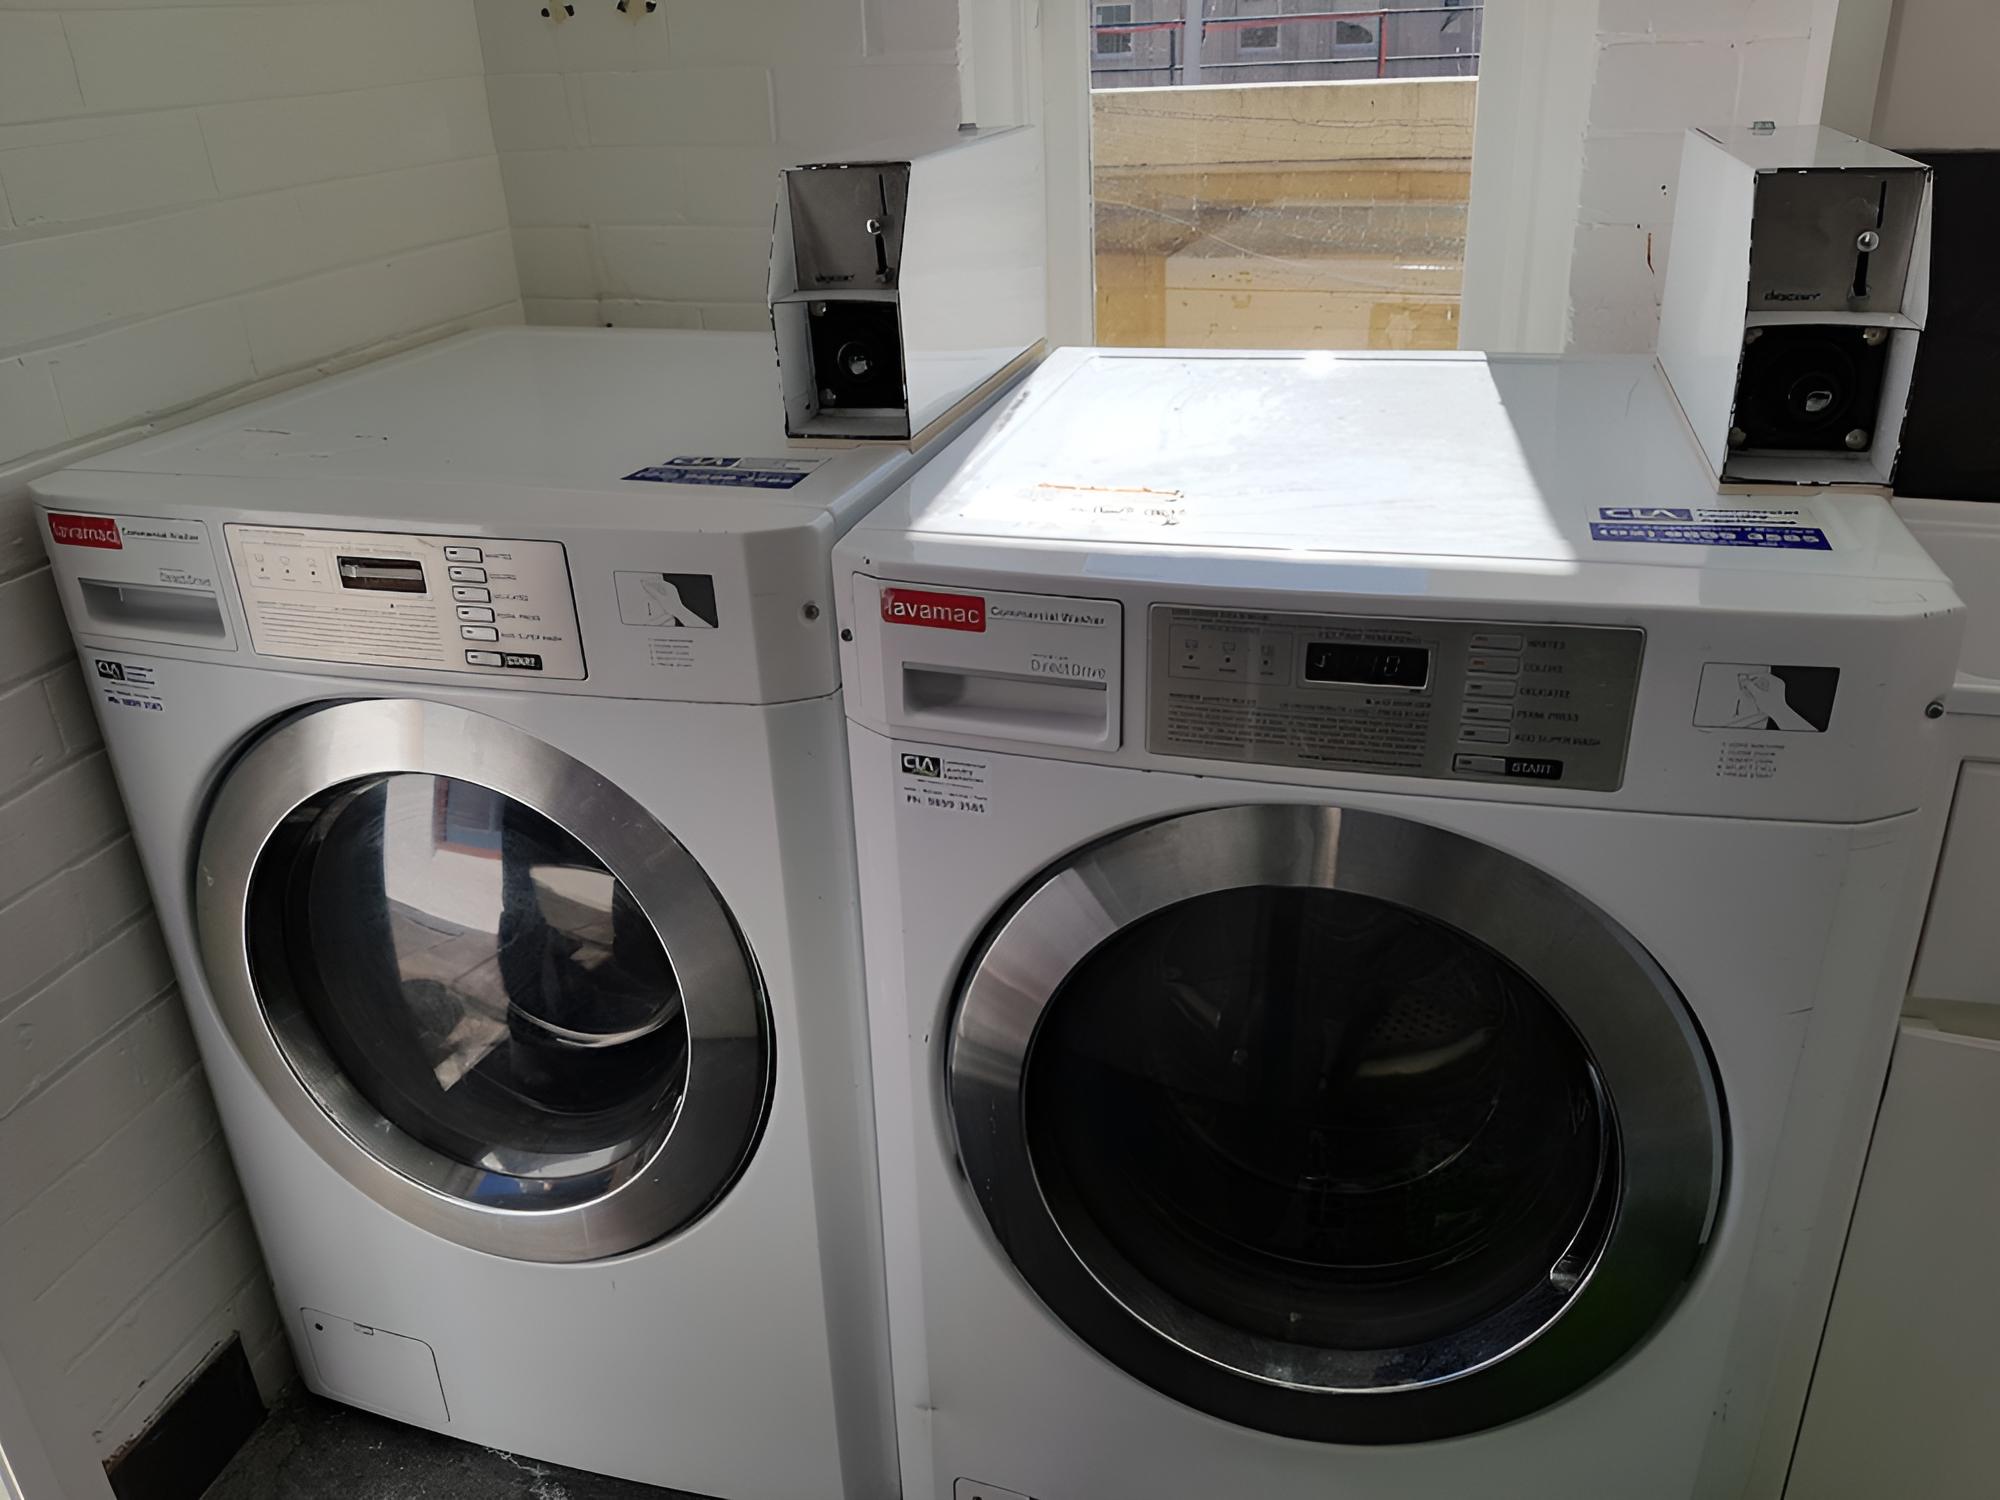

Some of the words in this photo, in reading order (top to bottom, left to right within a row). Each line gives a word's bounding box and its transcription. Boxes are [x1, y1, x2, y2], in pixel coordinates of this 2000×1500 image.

[886, 593, 980, 625] lavamac
[991, 606, 1058, 621] Commercial
[1060, 612, 1105, 626] Washer
[903, 755, 934, 772] CLA
